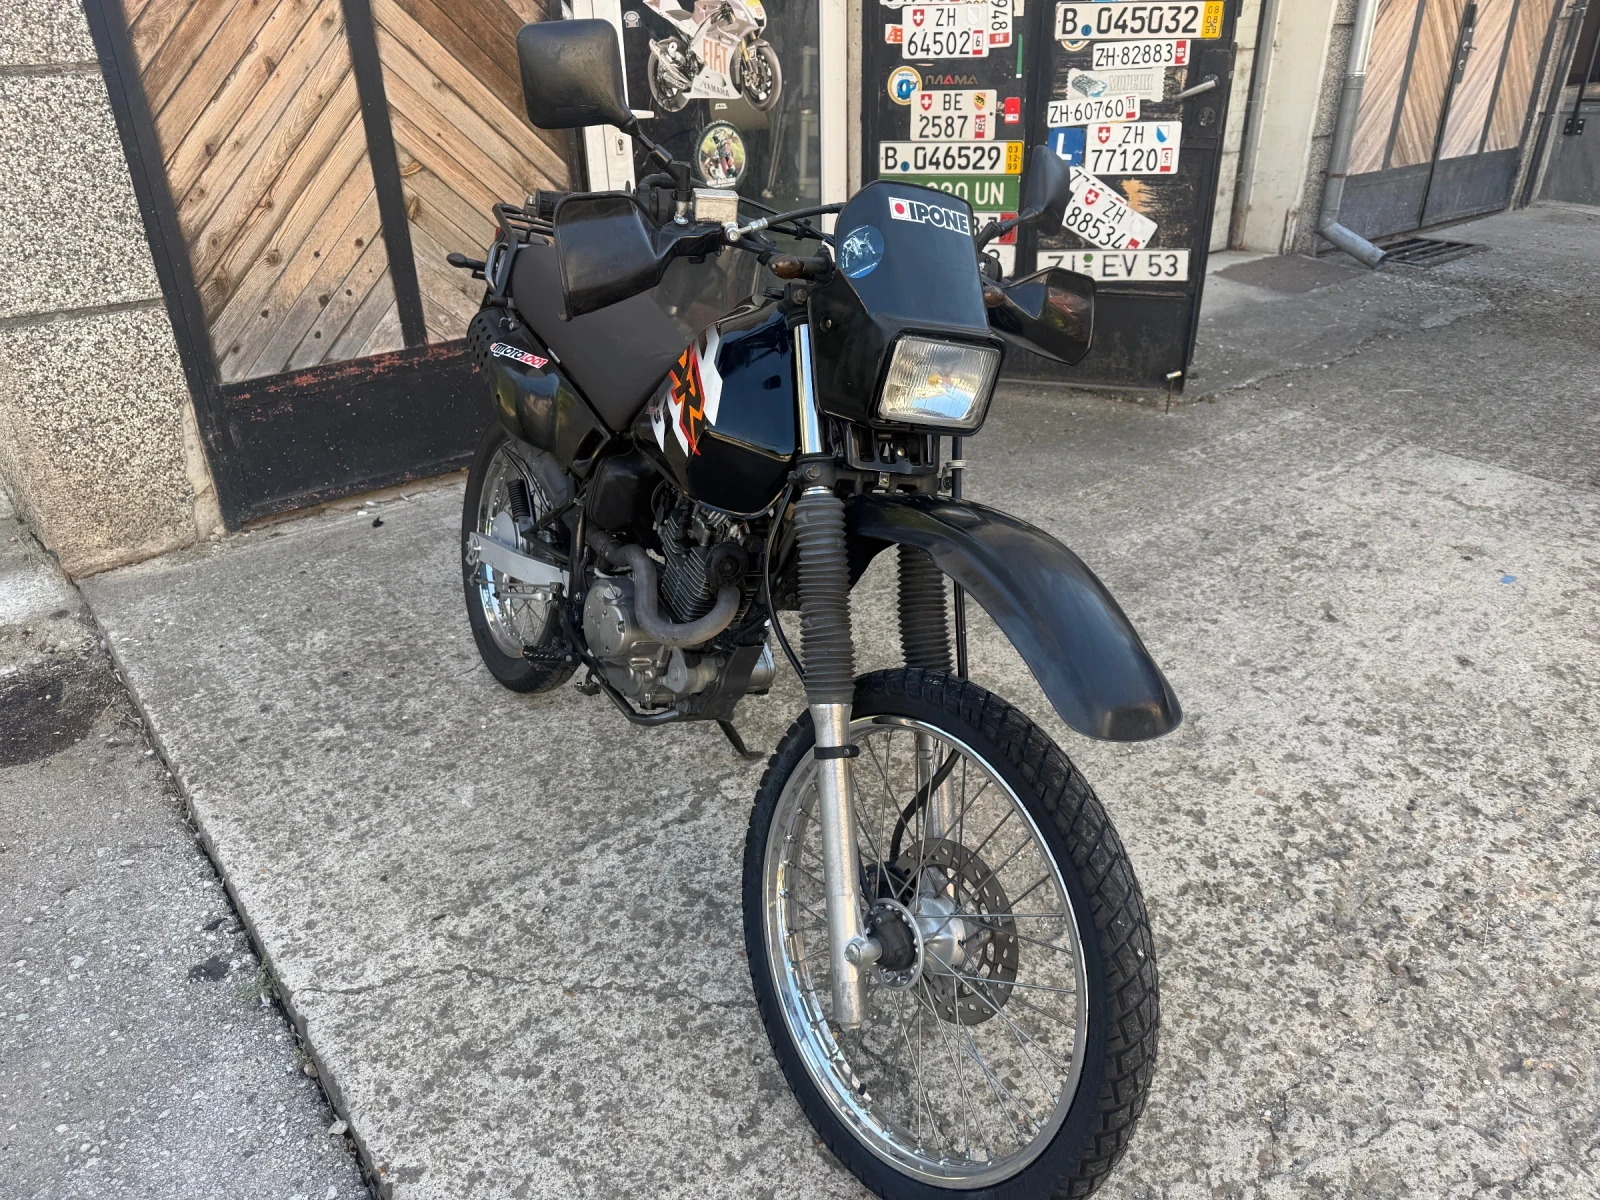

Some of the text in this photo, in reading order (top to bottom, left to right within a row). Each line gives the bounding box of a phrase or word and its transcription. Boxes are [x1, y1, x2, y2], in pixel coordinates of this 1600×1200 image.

[935, 8, 957, 27] ZH
[1061, 5, 1199, 34] B 045032
[908, 30, 971, 56] 64502
[702, 37, 729, 76] FIAT
[702, 82, 730, 98] YAMAHA
[943, 93, 963, 111] BE
[919, 115, 969, 138] 2587
[1122, 126, 1144, 144] ZH
[884, 146, 1001, 171] B 046529
[1008, 145, 1019, 153] 03
[1008, 154, 1018, 162] 12
[1056, 132, 1073, 161] L
[1091, 148, 1158, 172] 77120
[975, 181, 1005, 206] UN
[908, 200, 970, 236] IPONE
[1102, 200, 1127, 224] ZH
[1102, 254, 1139, 277] EV
[1148, 254, 1178, 277] 53
